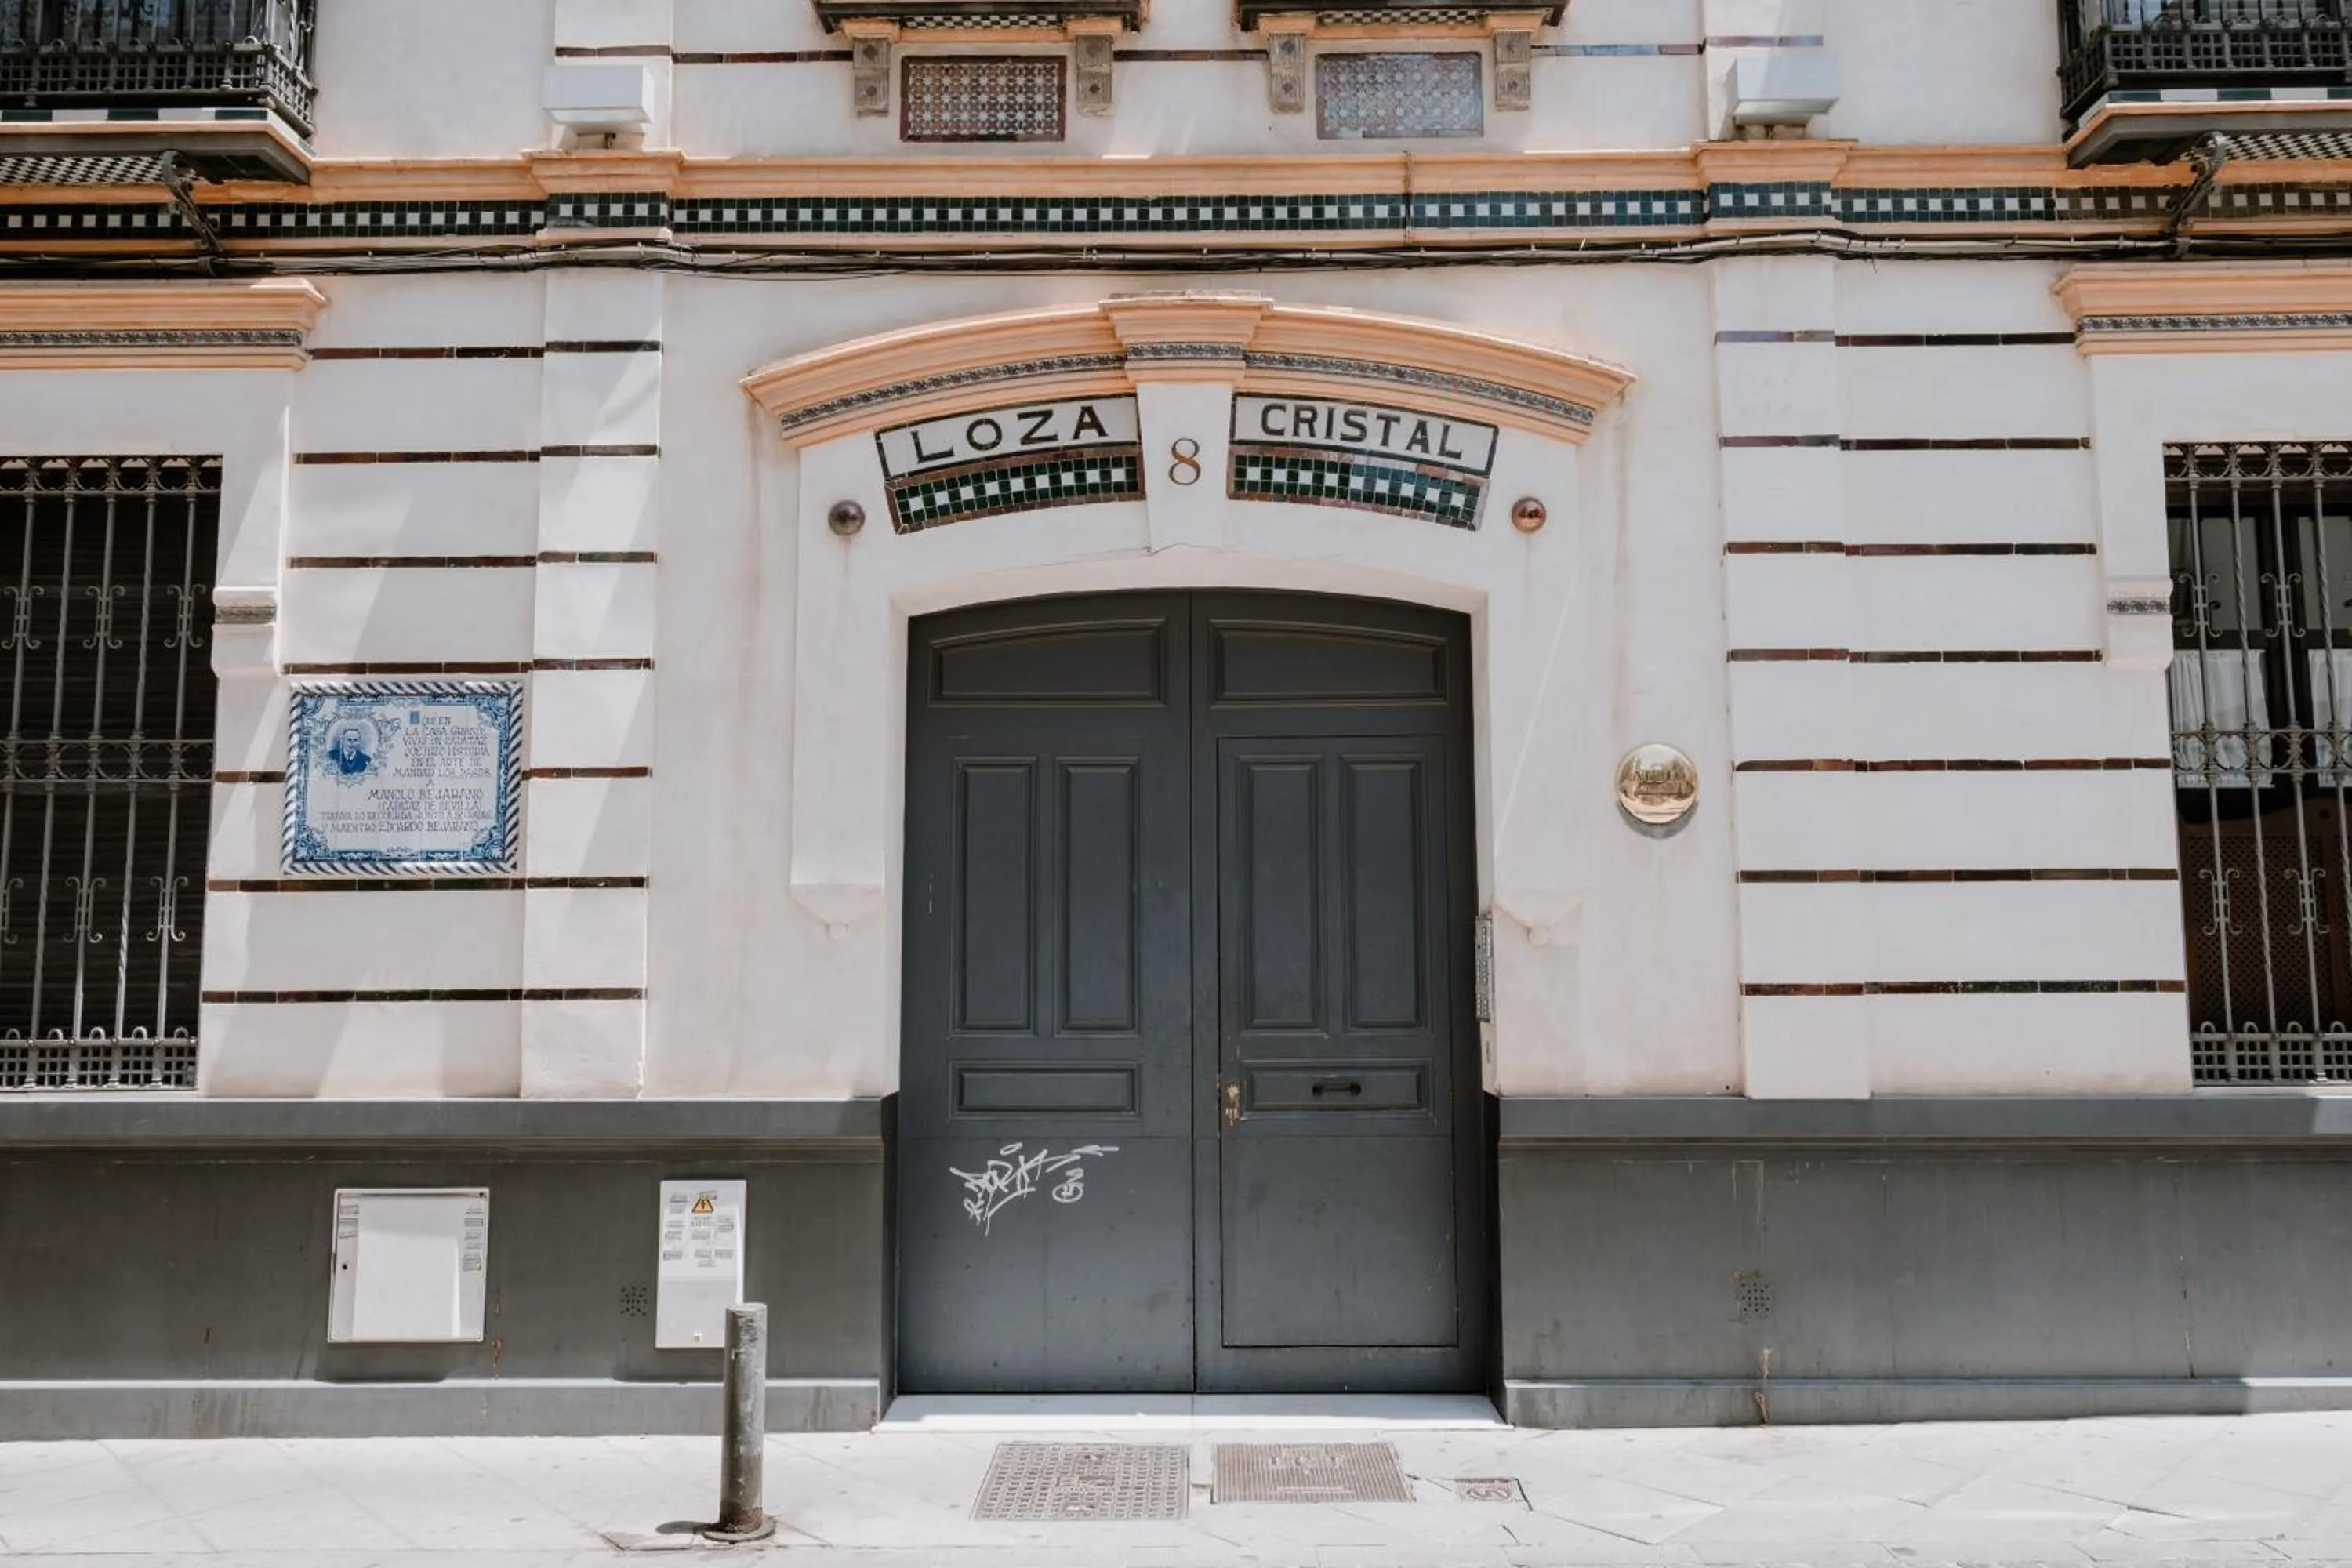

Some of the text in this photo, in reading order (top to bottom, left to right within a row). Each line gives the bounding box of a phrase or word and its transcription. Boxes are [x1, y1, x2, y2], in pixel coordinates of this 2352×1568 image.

[911, 405, 1109, 464] LOZA
[1261, 403, 1462, 460] CRISTAL
[1168, 437, 1201, 485] 8
